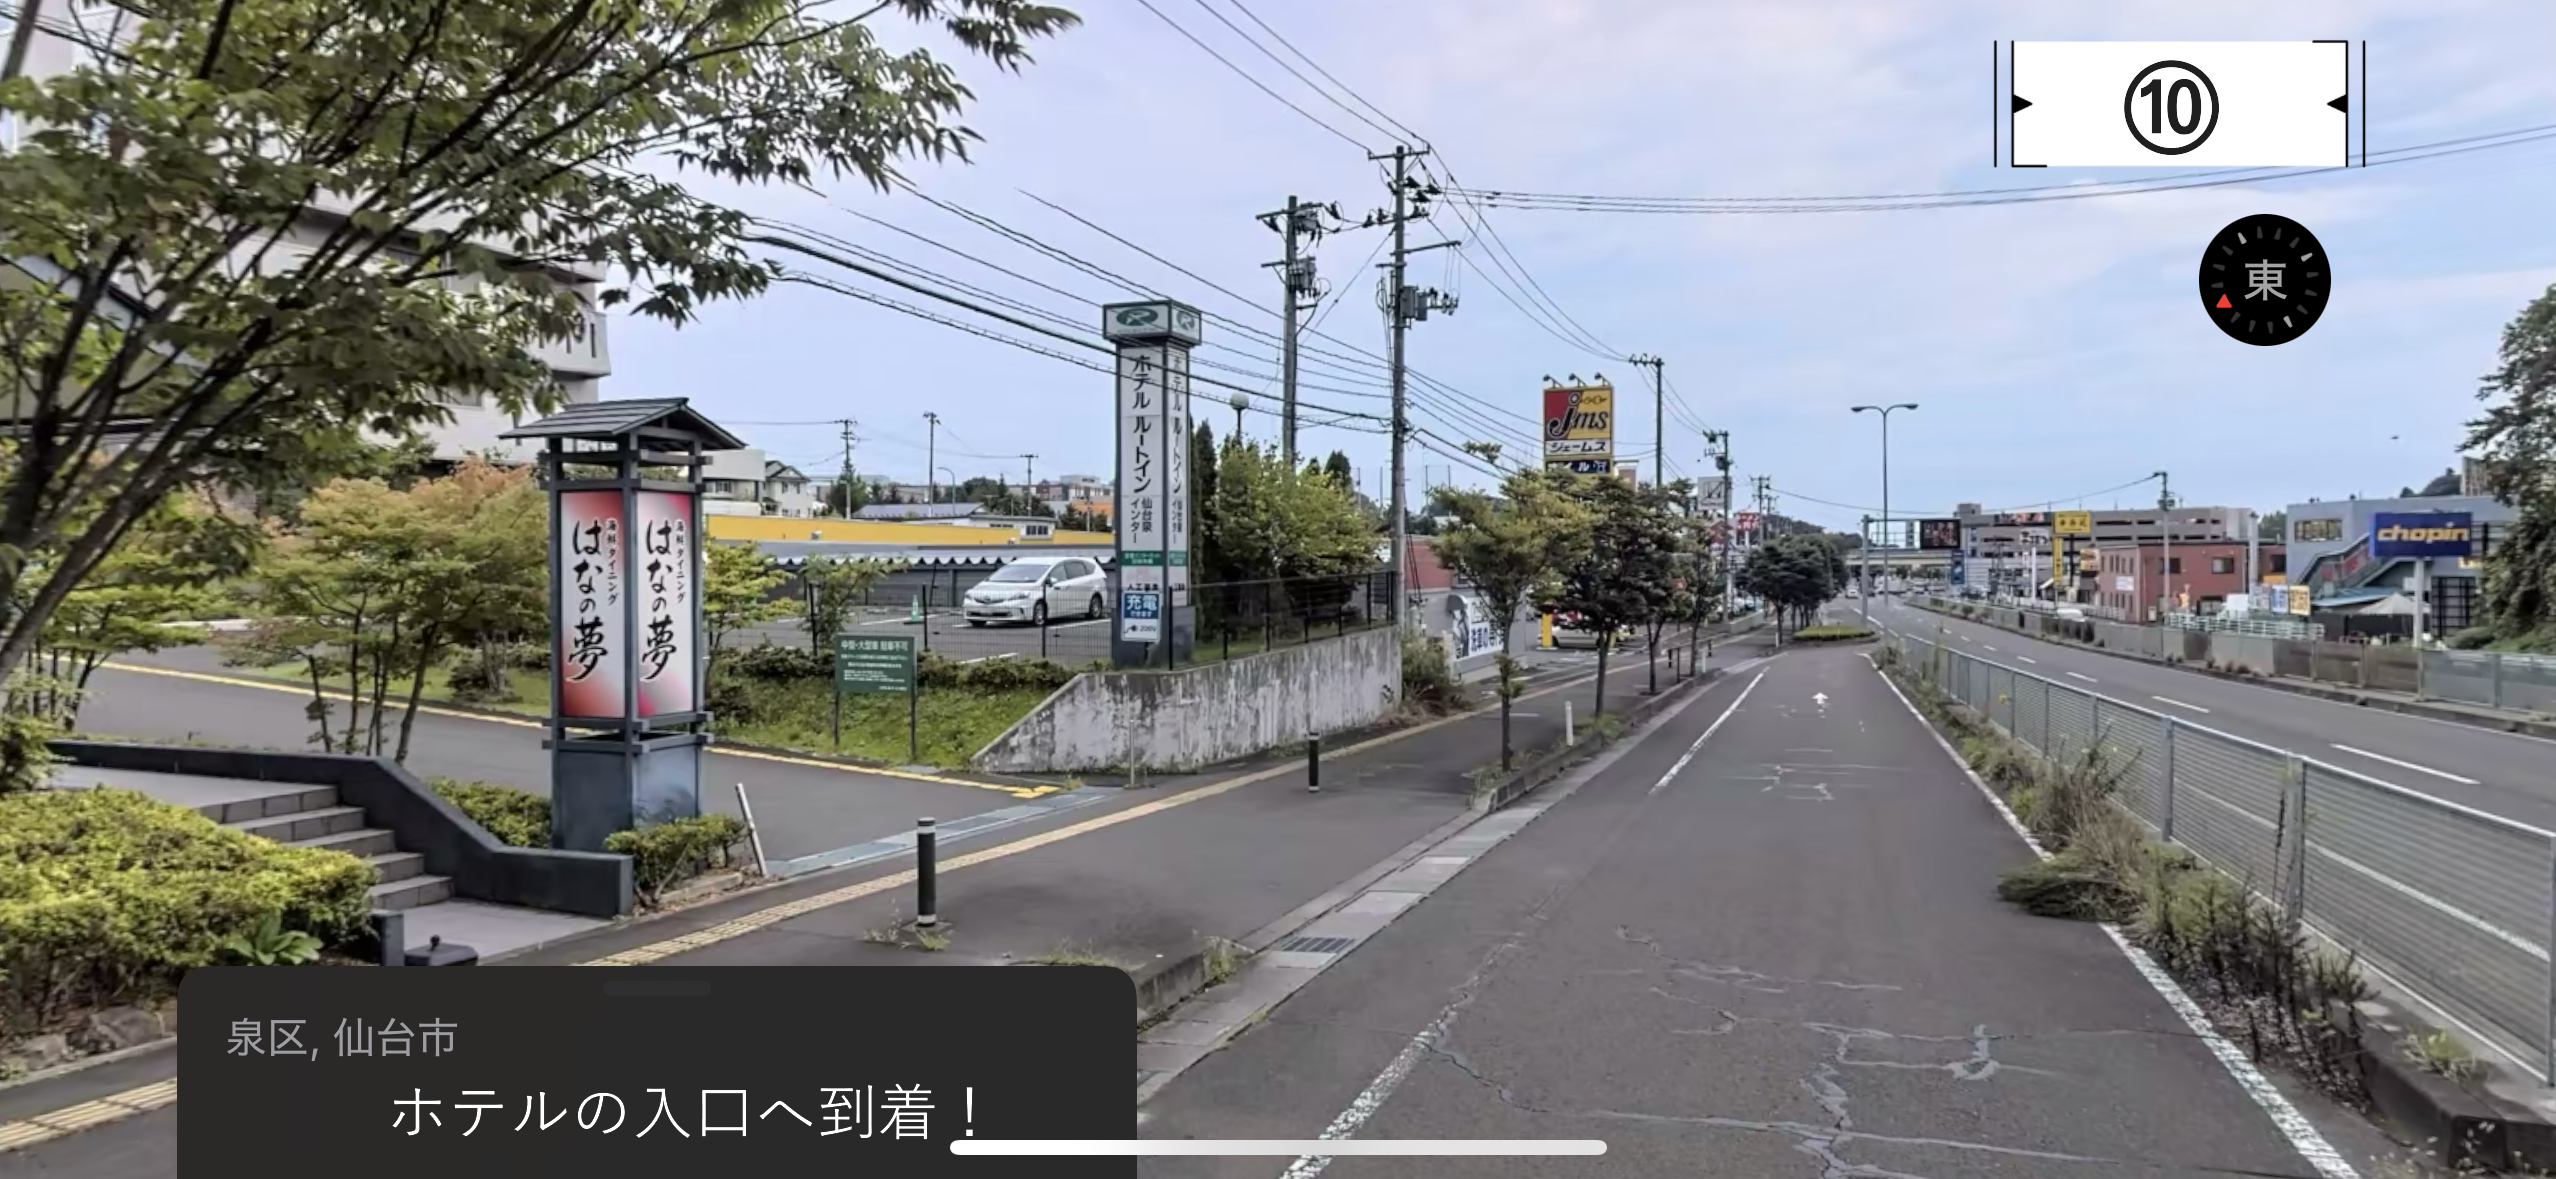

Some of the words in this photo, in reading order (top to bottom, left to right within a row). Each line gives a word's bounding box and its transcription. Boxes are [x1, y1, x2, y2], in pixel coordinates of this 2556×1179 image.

[1132, 355, 1151, 409] ホテル
[1133, 416, 1152, 493] ルートイン
[1173, 417, 1182, 493] ルートイン
[1549, 441, 1606, 452] ジェームス
[1131, 498, 1140, 543] インター
[1141, 498, 1152, 532] 仙台泉
[2378, 522, 2468, 544] chopin
[566, 519, 608, 680] はなの夢
[640, 519, 677, 680] はなの夢
[1126, 595, 1157, 610] 充電
